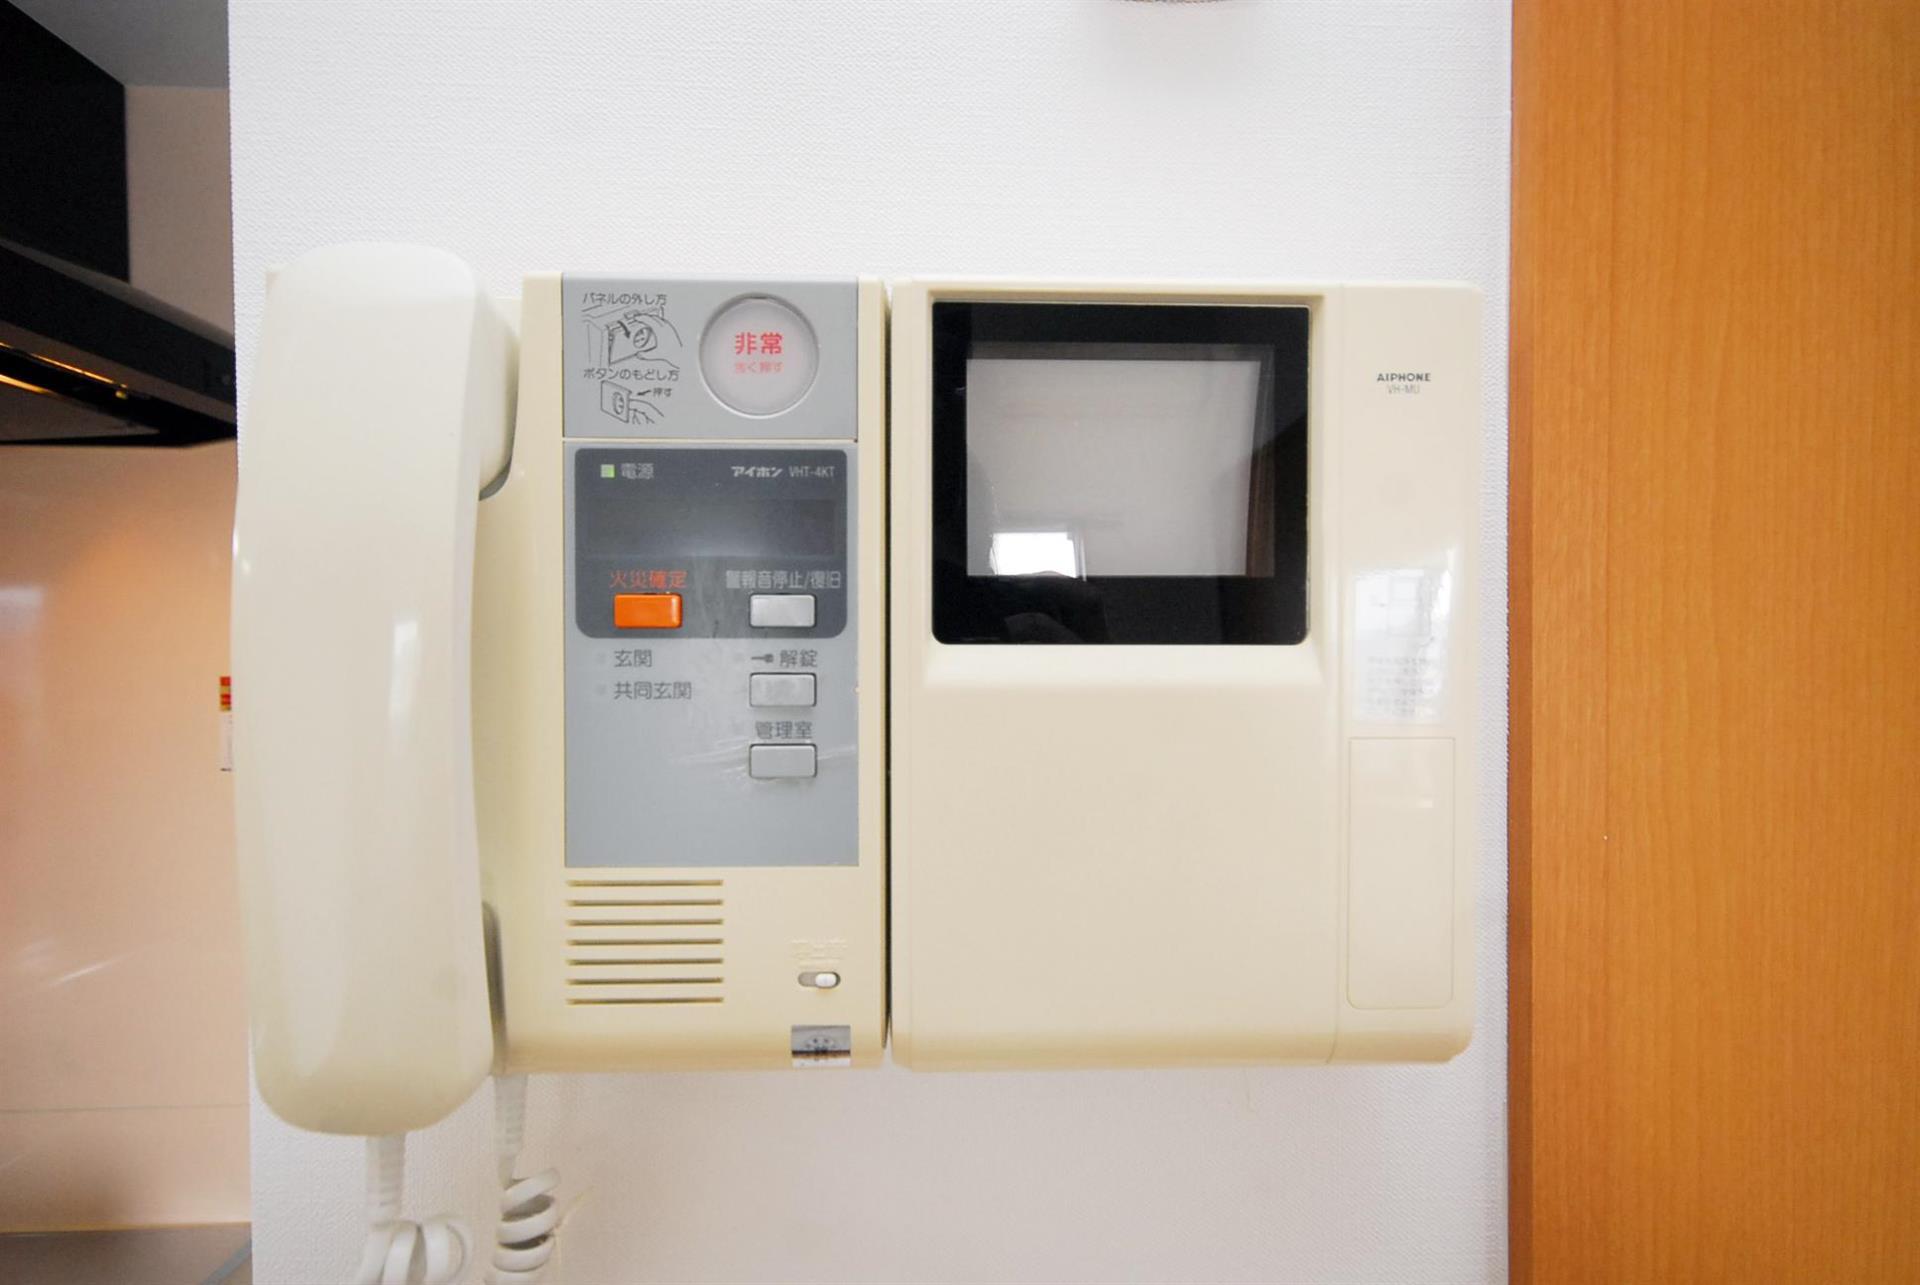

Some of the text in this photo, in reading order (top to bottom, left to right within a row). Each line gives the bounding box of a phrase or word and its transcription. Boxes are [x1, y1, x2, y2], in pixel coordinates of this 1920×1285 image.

[582, 291, 667, 306] パネルの外し方
[735, 331, 784, 355] 非常
[1376, 372, 1432, 382] AIPHONE
[621, 462, 654, 480] 電源
[731, 465, 836, 478] アイホン VHT-4KT
[609, 570, 688, 589] 火災確定
[613, 649, 653, 668] 玄関
[779, 649, 818, 668] 解錠
[613, 680, 693, 701] 共同玄関
[754, 720, 814, 740] 管理室
